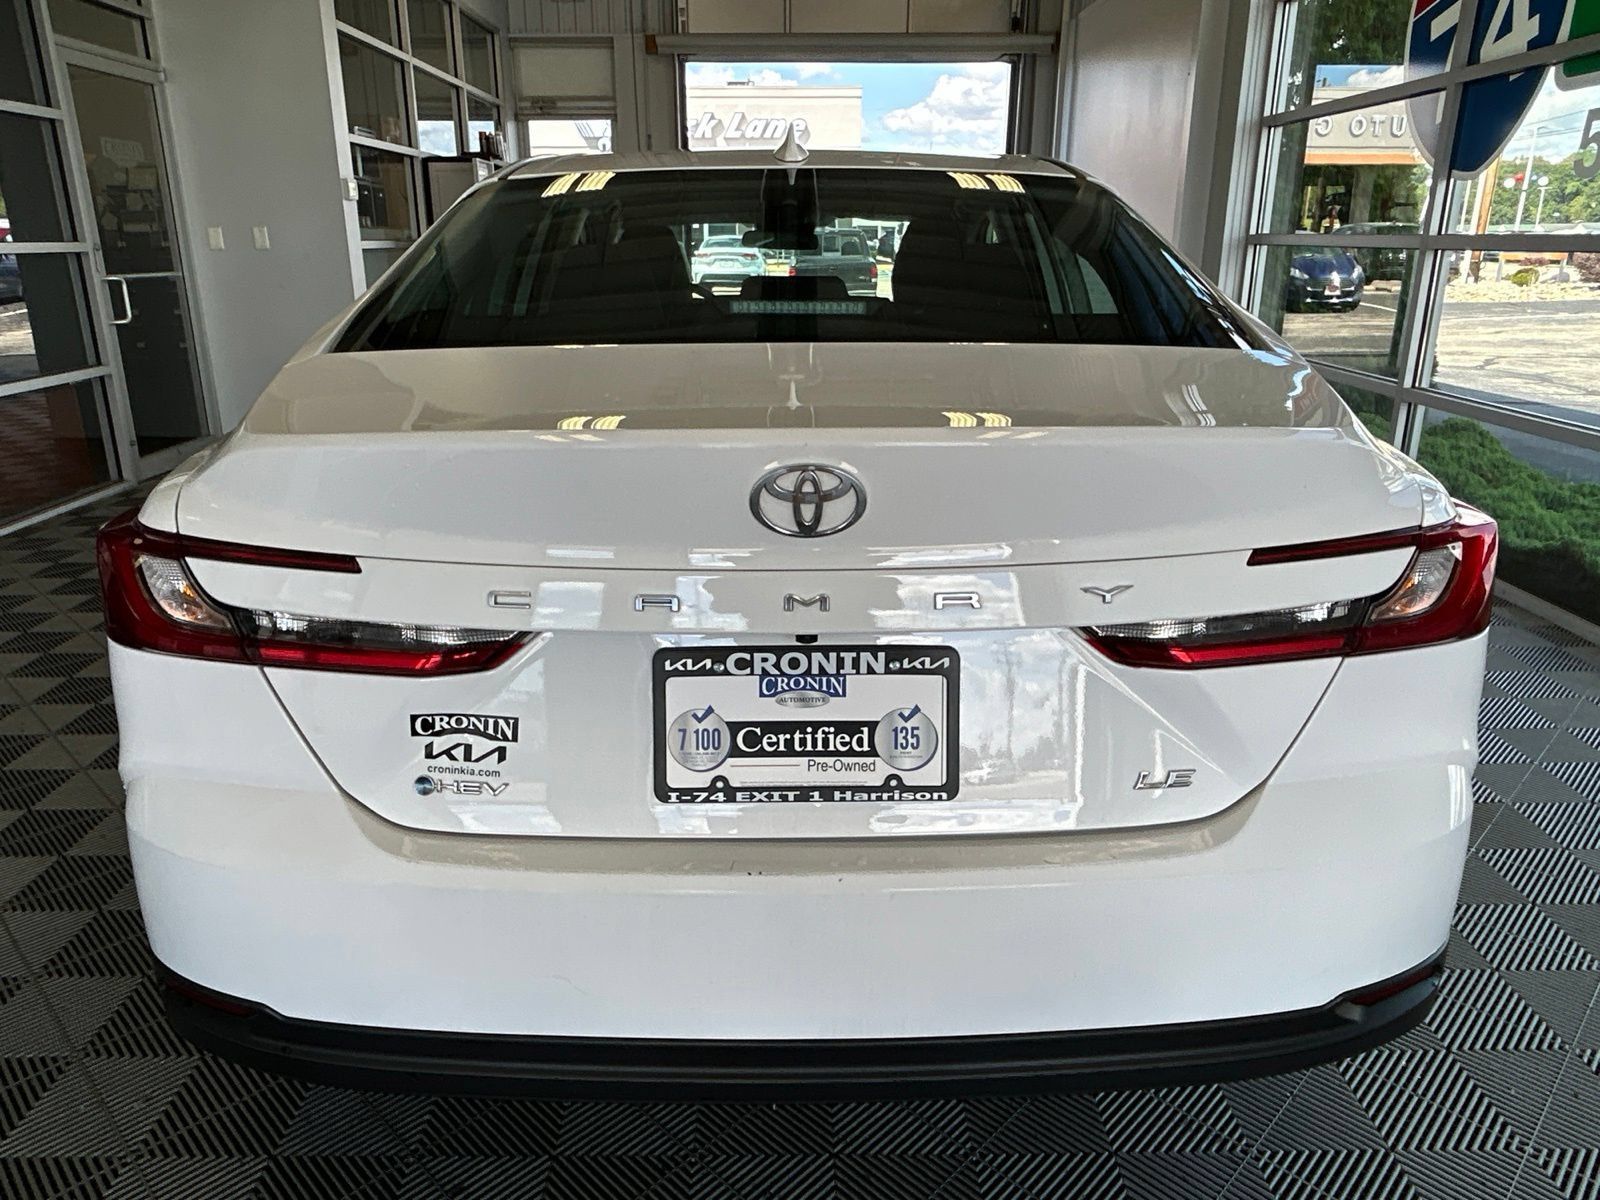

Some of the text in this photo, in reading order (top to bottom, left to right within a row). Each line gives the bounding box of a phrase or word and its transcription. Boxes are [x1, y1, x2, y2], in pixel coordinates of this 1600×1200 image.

[726, 112, 810, 145] Lane
[486, 584, 1134, 613] CAMRY
[664, 652, 950, 675] KIA CRONIN KIA
[761, 676, 845, 695] CRONIN
[779, 695, 826, 704] AUTOMOTIVE
[415, 715, 515, 742] CRONIN
[678, 728, 722, 751] 7 100
[736, 727, 870, 752] Certified
[892, 726, 920, 751] 135
[425, 741, 507, 764] KIA
[427, 765, 501, 778] croninkia.com
[807, 758, 876, 773] Pre-Owned
[434, 778, 510, 797] HEV
[1133, 768, 1197, 790] LE
[667, 790, 949, 803] I-74 EXIT 1 Harrison
